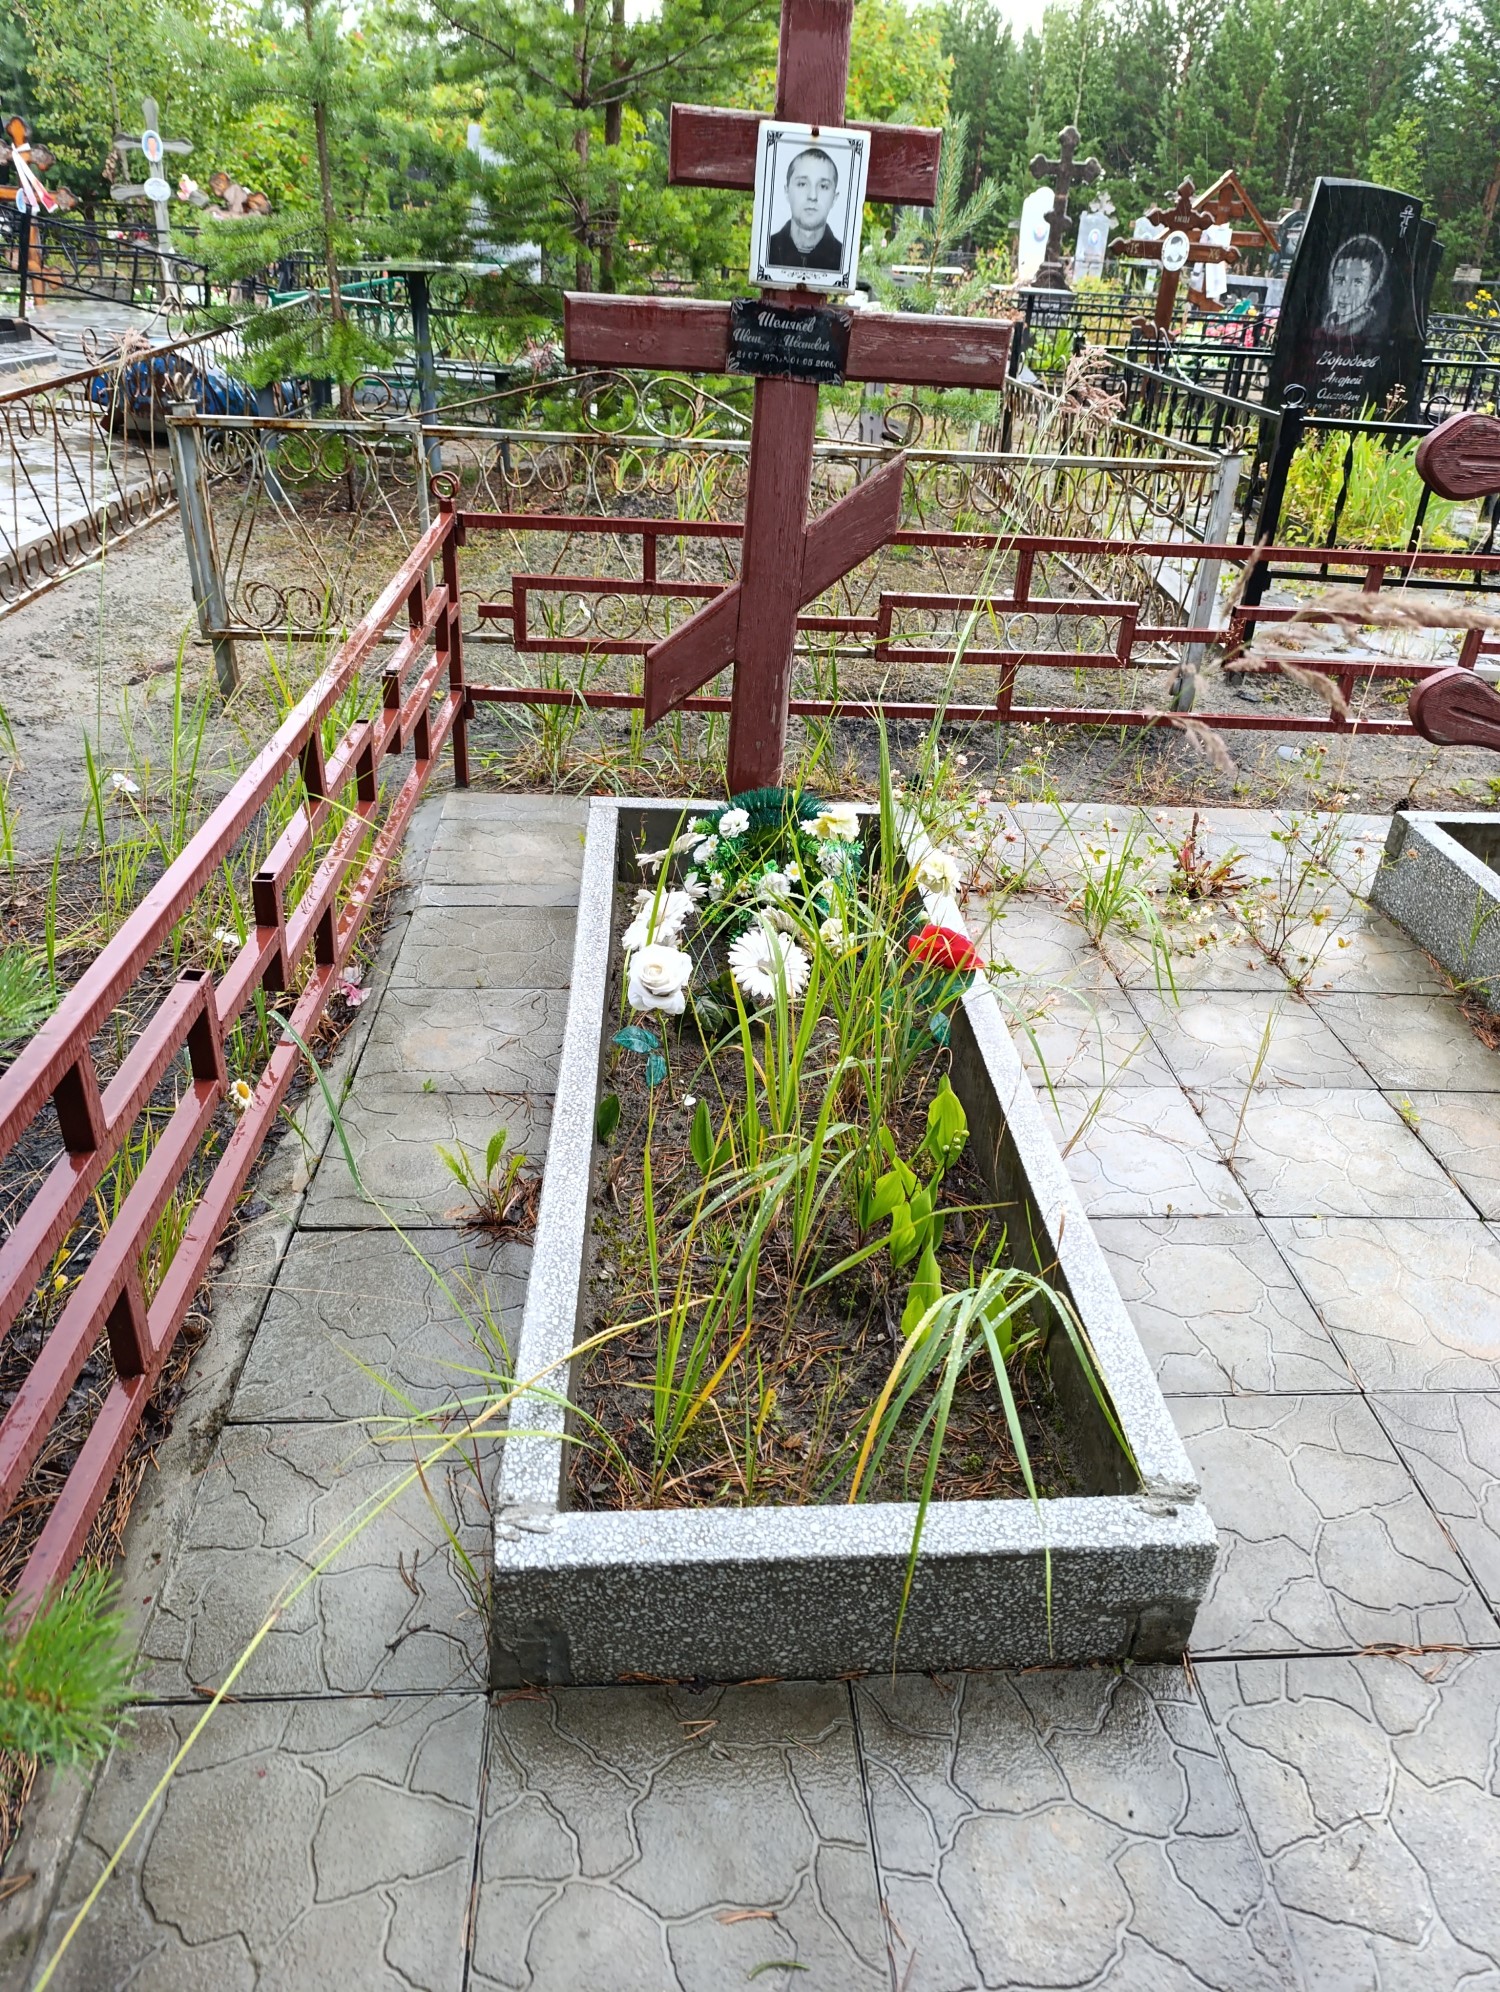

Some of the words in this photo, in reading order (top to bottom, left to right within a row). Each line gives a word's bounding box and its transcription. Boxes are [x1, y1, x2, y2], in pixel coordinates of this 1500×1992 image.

[732, 327, 762, 343] Иван
[783, 334, 831, 351] Иванович
[1315, 350, 1381, 370] Воробьев
[1321, 371, 1364, 387] Андрей
[1316, 387, 1361, 401] Олегович
